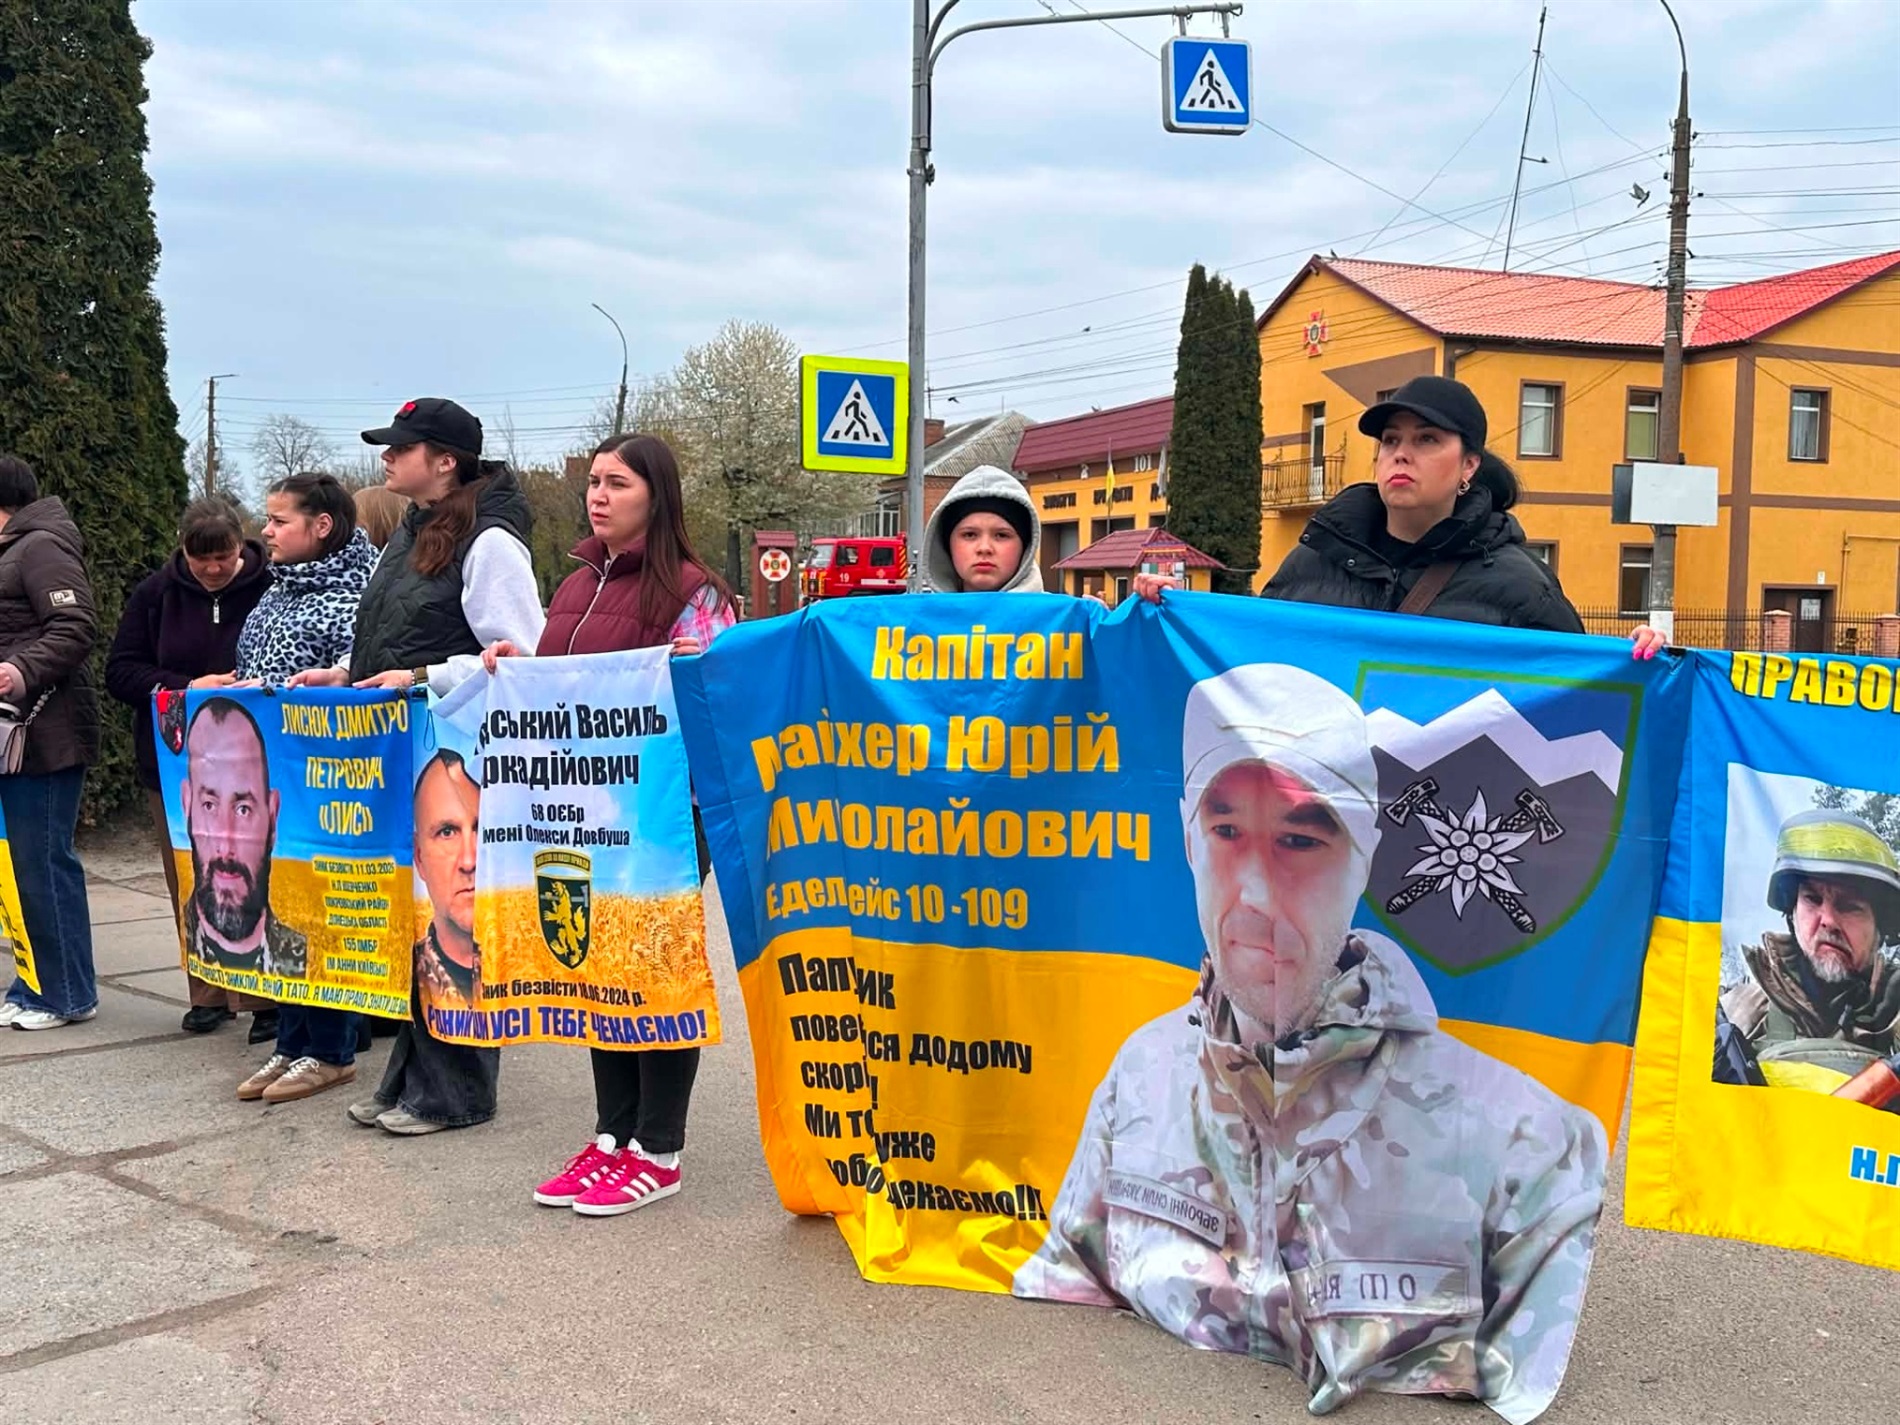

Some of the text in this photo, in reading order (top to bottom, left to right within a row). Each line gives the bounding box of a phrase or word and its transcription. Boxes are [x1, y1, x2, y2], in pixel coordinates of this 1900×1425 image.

[1134, 455, 1152, 472] 101
[840, 572, 850, 584] 19
[871, 624, 1083, 680] Капітан
[1731, 651, 1900, 715] ПРАВО
[281, 699, 408, 741] ЛИСЮК ДМИТРО
[575, 704, 668, 740] Василь
[946, 712, 1120, 779] Юрій
[306, 756, 385, 790] ПЕТРОВИЧ
[531, 803, 584, 824] 68 ОЄБр
[767, 796, 1150, 862] Миолайович
[525, 824, 569, 845] Олекси
[573, 827, 630, 847] Довбуша
[906, 885, 945, 924] 10
[343, 937, 356, 951] 155
[286, 982, 310, 1000] ТАТО.
[312, 986, 320, 1001] Я
[321, 986, 343, 1004] МАЮ
[511, 979, 577, 998] безвісти
[631, 991, 647, 1008] р.
[490, 1007, 531, 1040] УСІ
[537, 1006, 587, 1039] ТЕБЕ
[591, 1008, 707, 1044] ЧЕКАЄМО!
[909, 1033, 1032, 1075] додому
[804, 1102, 842, 1138] Ми
